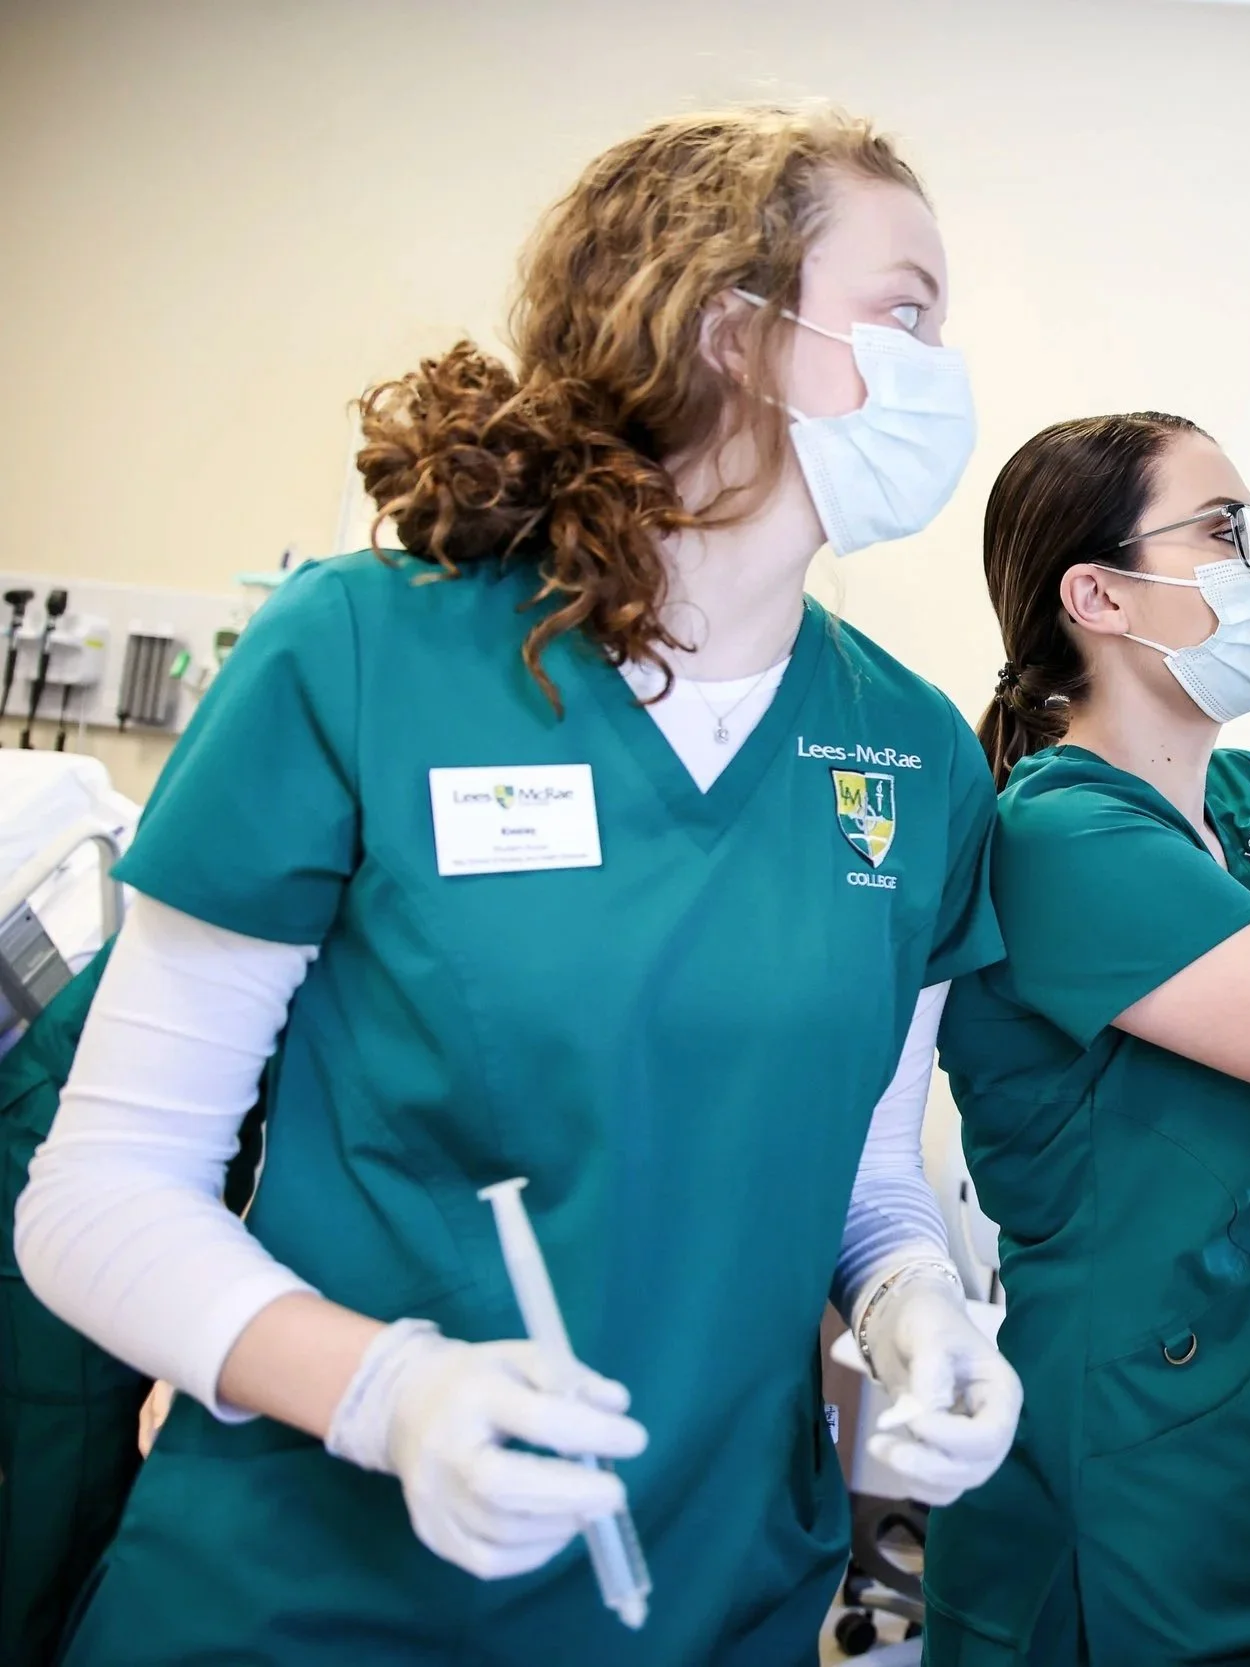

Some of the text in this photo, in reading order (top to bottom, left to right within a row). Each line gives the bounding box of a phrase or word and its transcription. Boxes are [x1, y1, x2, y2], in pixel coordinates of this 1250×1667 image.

[797, 736, 922, 769] Lees-McRae
[453, 787, 574, 804] Lees McRae
[846, 872, 897, 889] COLLEGE
